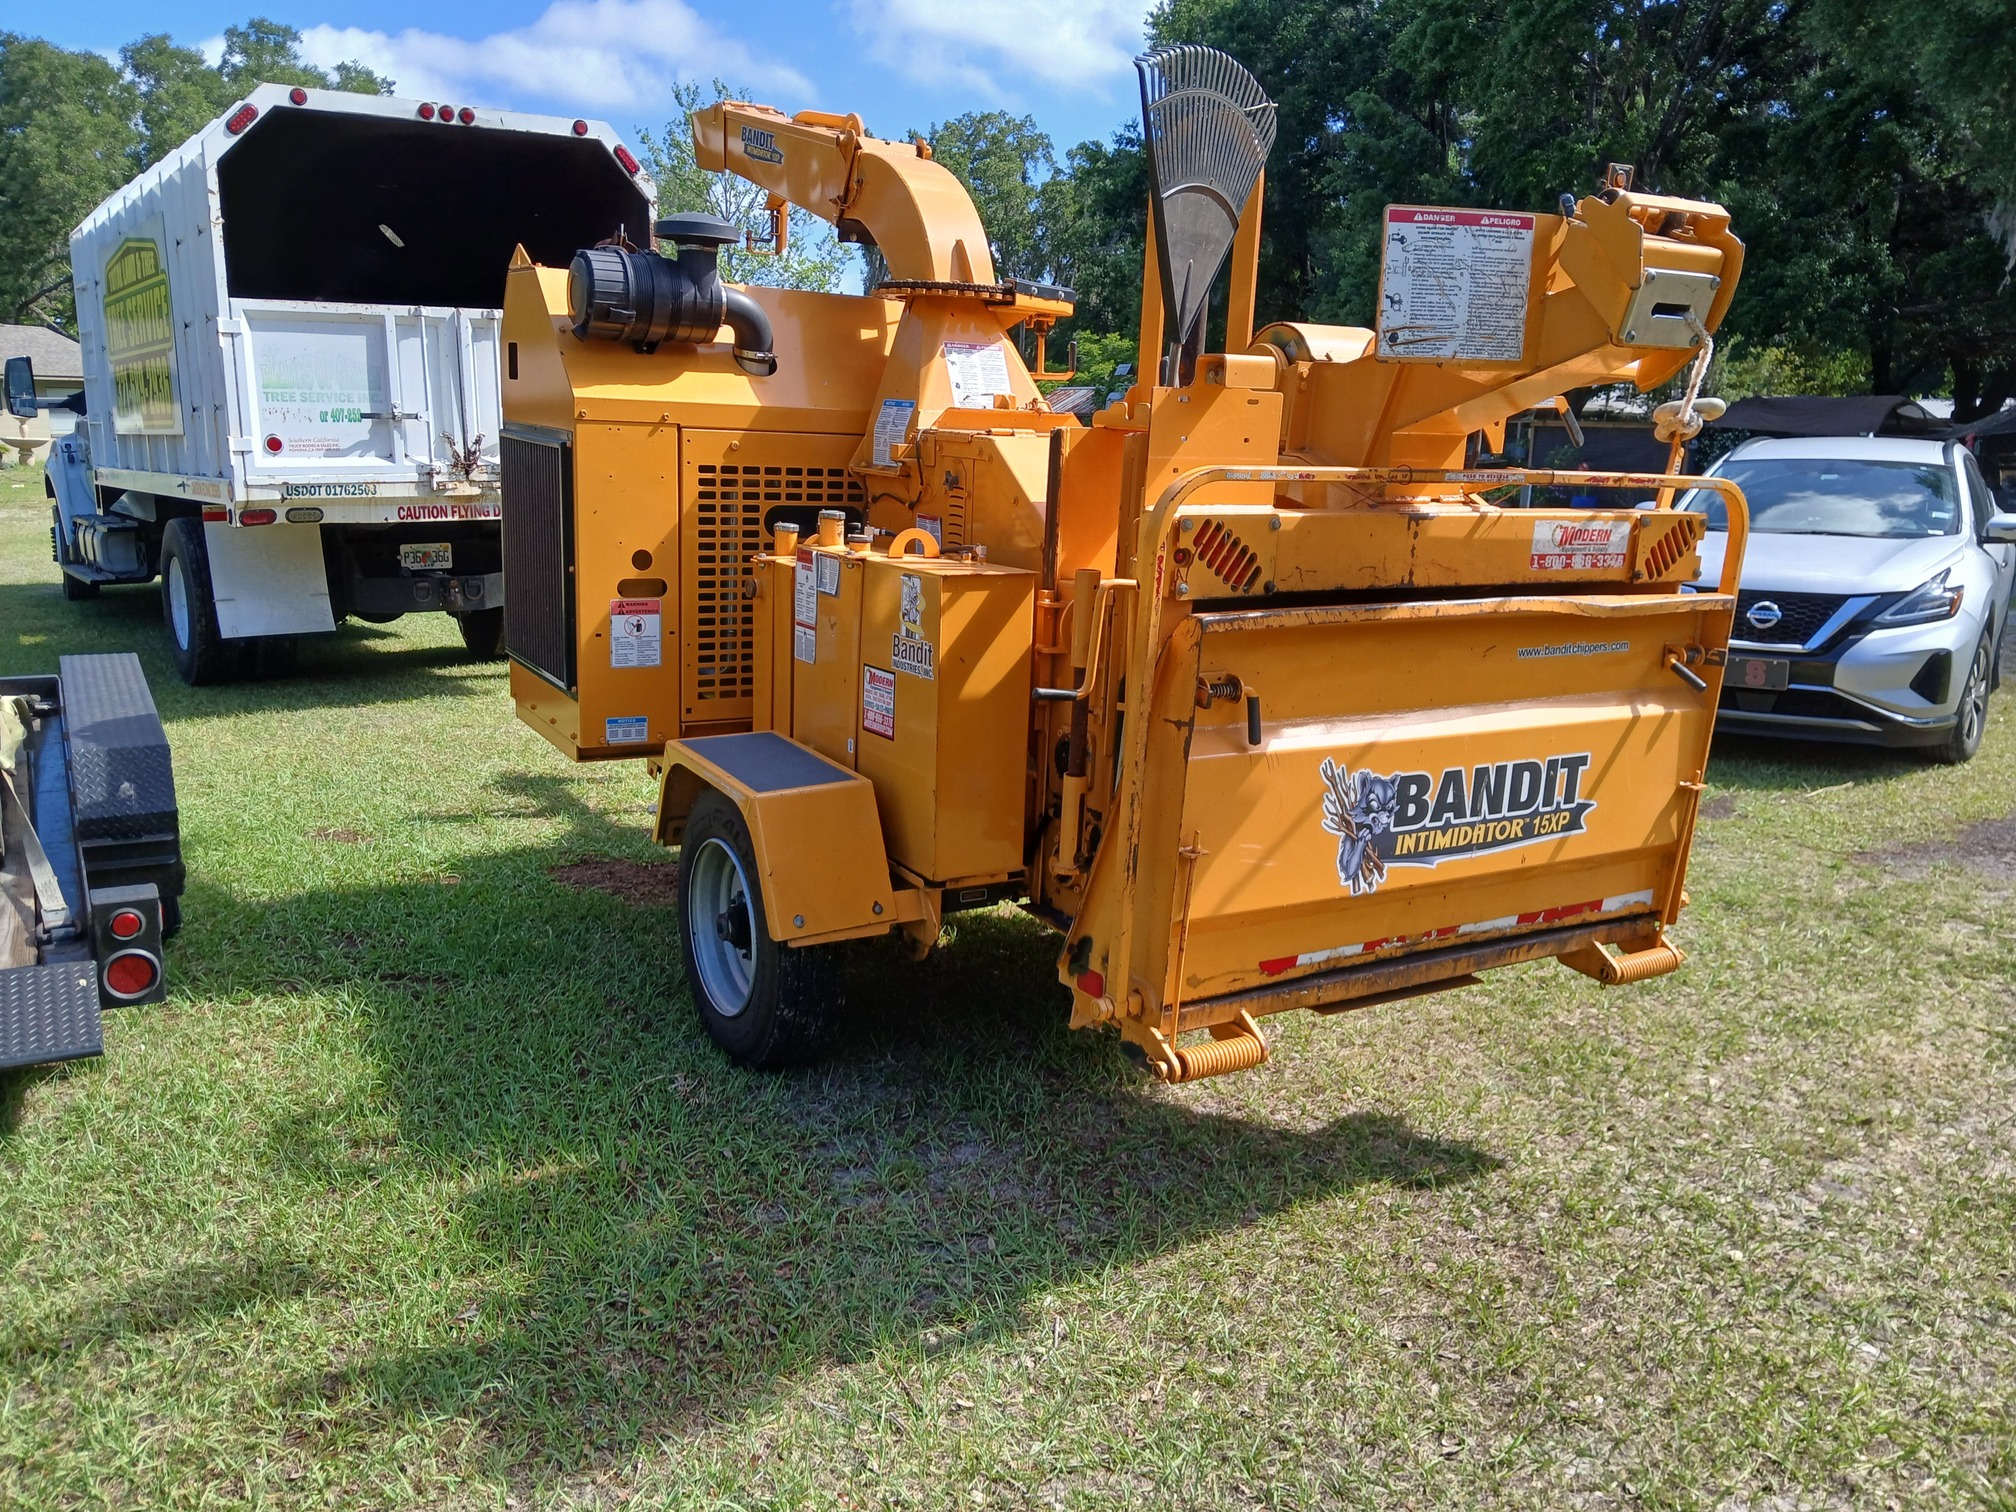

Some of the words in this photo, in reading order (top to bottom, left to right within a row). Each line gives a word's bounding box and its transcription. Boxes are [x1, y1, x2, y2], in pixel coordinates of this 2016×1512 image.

[741, 126, 774, 149] BANDIT
[1489, 217, 1521, 226] PELIGRO
[105, 300, 128, 352] TREE
[126, 284, 170, 347] SERVICE
[263, 391, 297, 403] TREE
[300, 392, 354, 403] SERVICE
[358, 392, 383, 403] INC.
[320, 410, 328, 422] or
[313, 436, 340, 444] California
[286, 485, 322, 496] USDOT
[398, 505, 449, 520] CAUTION
[451, 504, 490, 519] FLYING
[1559, 526, 1612, 546] MODERN
[404, 550, 421, 564] P36
[432, 550, 449, 562] 36G
[893, 635, 932, 667] Bandit
[1518, 641, 1629, 658] www.banditchippers.com
[1393, 755, 1589, 828] BANDIT
[1532, 811, 1571, 835] 15XP
